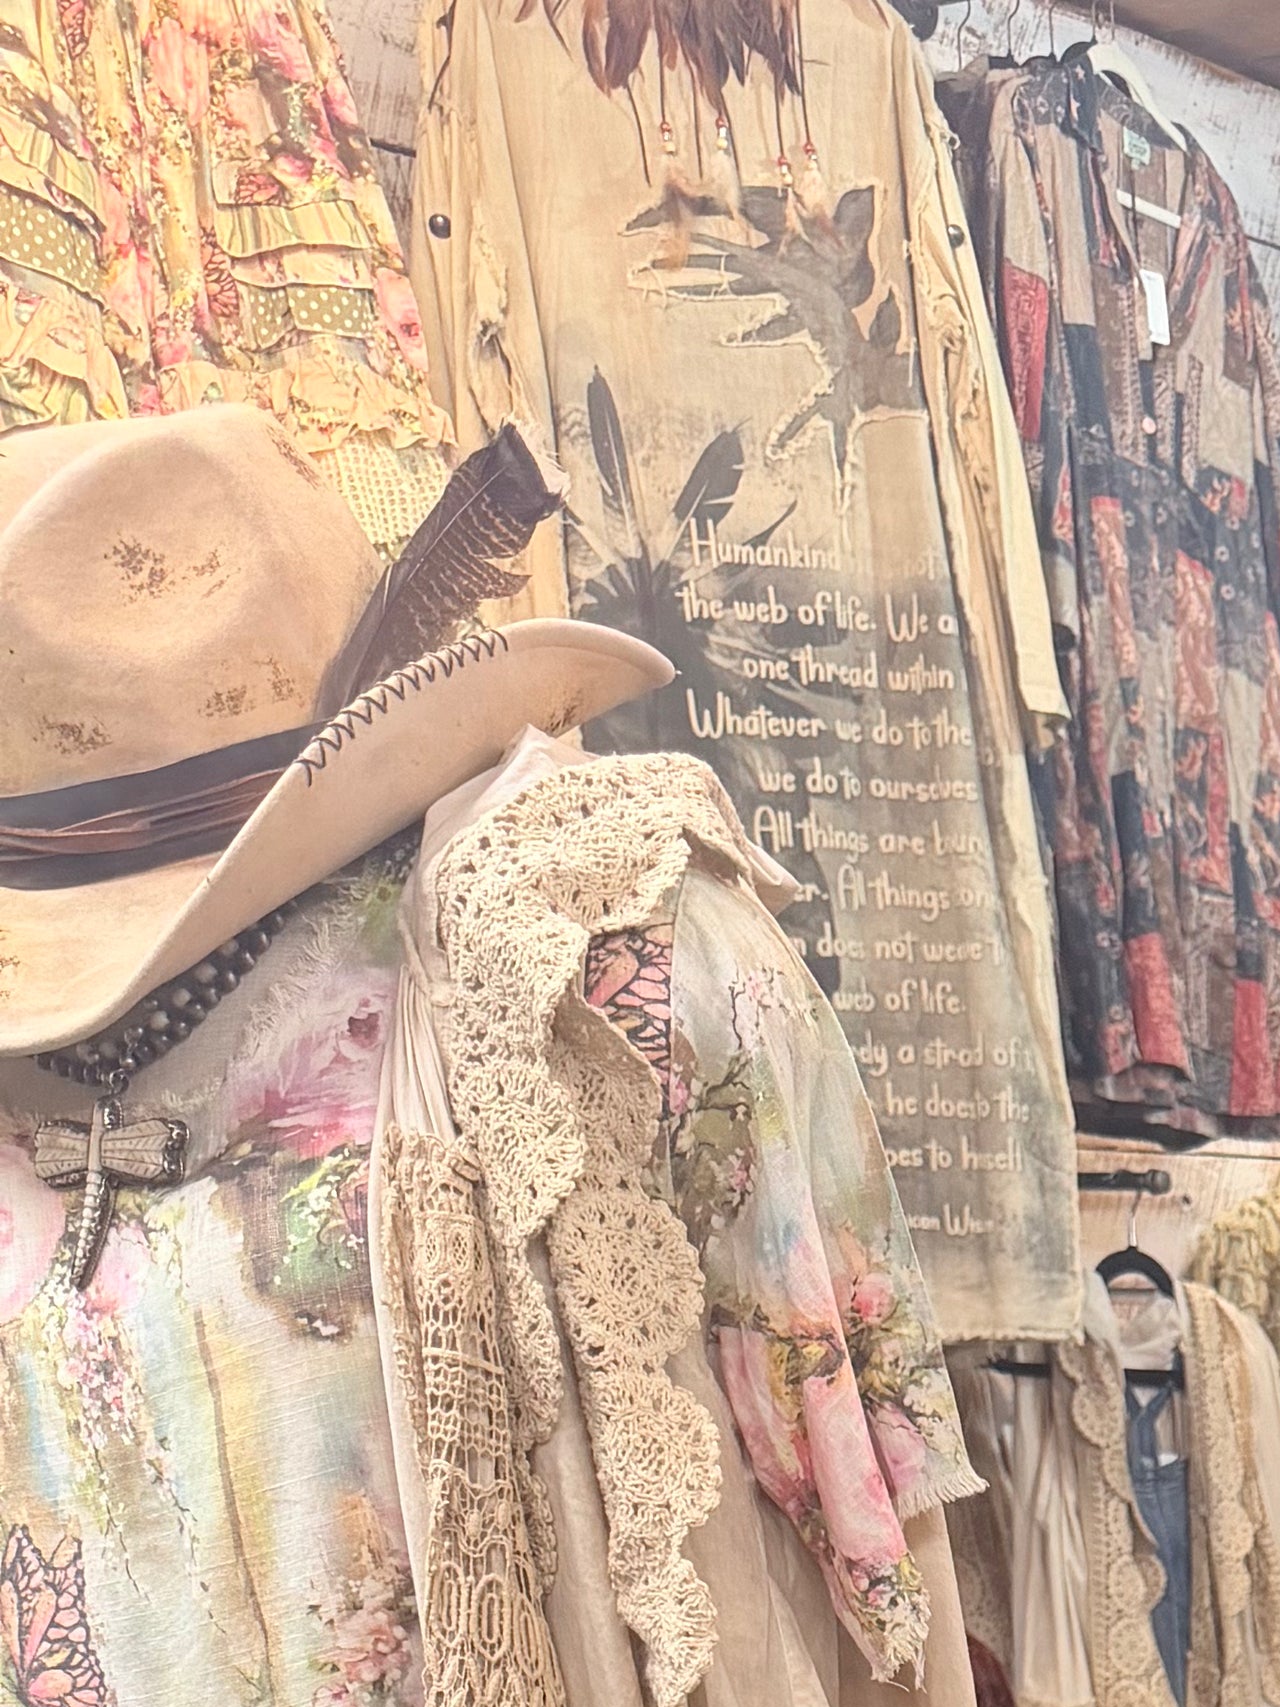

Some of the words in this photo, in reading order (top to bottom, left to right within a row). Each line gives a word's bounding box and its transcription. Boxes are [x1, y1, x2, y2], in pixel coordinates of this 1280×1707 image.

[686, 517, 841, 571] Humankind
[675, 581, 725, 622] the
[733, 585, 788, 624] web
[798, 590, 832, 626] of
[835, 590, 877, 632] life.
[885, 592, 928, 642] We
[743, 656, 789, 679] one
[791, 643, 879, 687] thread
[888, 653, 954, 695] within
[687, 688, 827, 740] Whatever
[835, 721, 862, 743] we
[872, 708, 903, 745] do
[907, 716, 931, 750] to
[933, 707, 972, 749] the
[758, 769, 796, 793] we
[806, 756, 838, 795] do
[839, 766, 861, 799] to
[754, 805, 794, 853] All
[795, 811, 869, 864] things
[878, 833, 925, 855] are
[868, 871, 950, 921] things
[875, 931, 919, 964] not
[885, 979, 918, 1011] of
[920, 977, 966, 1014] life.
[897, 1043, 915, 1065] a
[993, 1035, 1022, 1068] of
[886, 1081, 918, 1116] he
[923, 1138, 953, 1172] to
